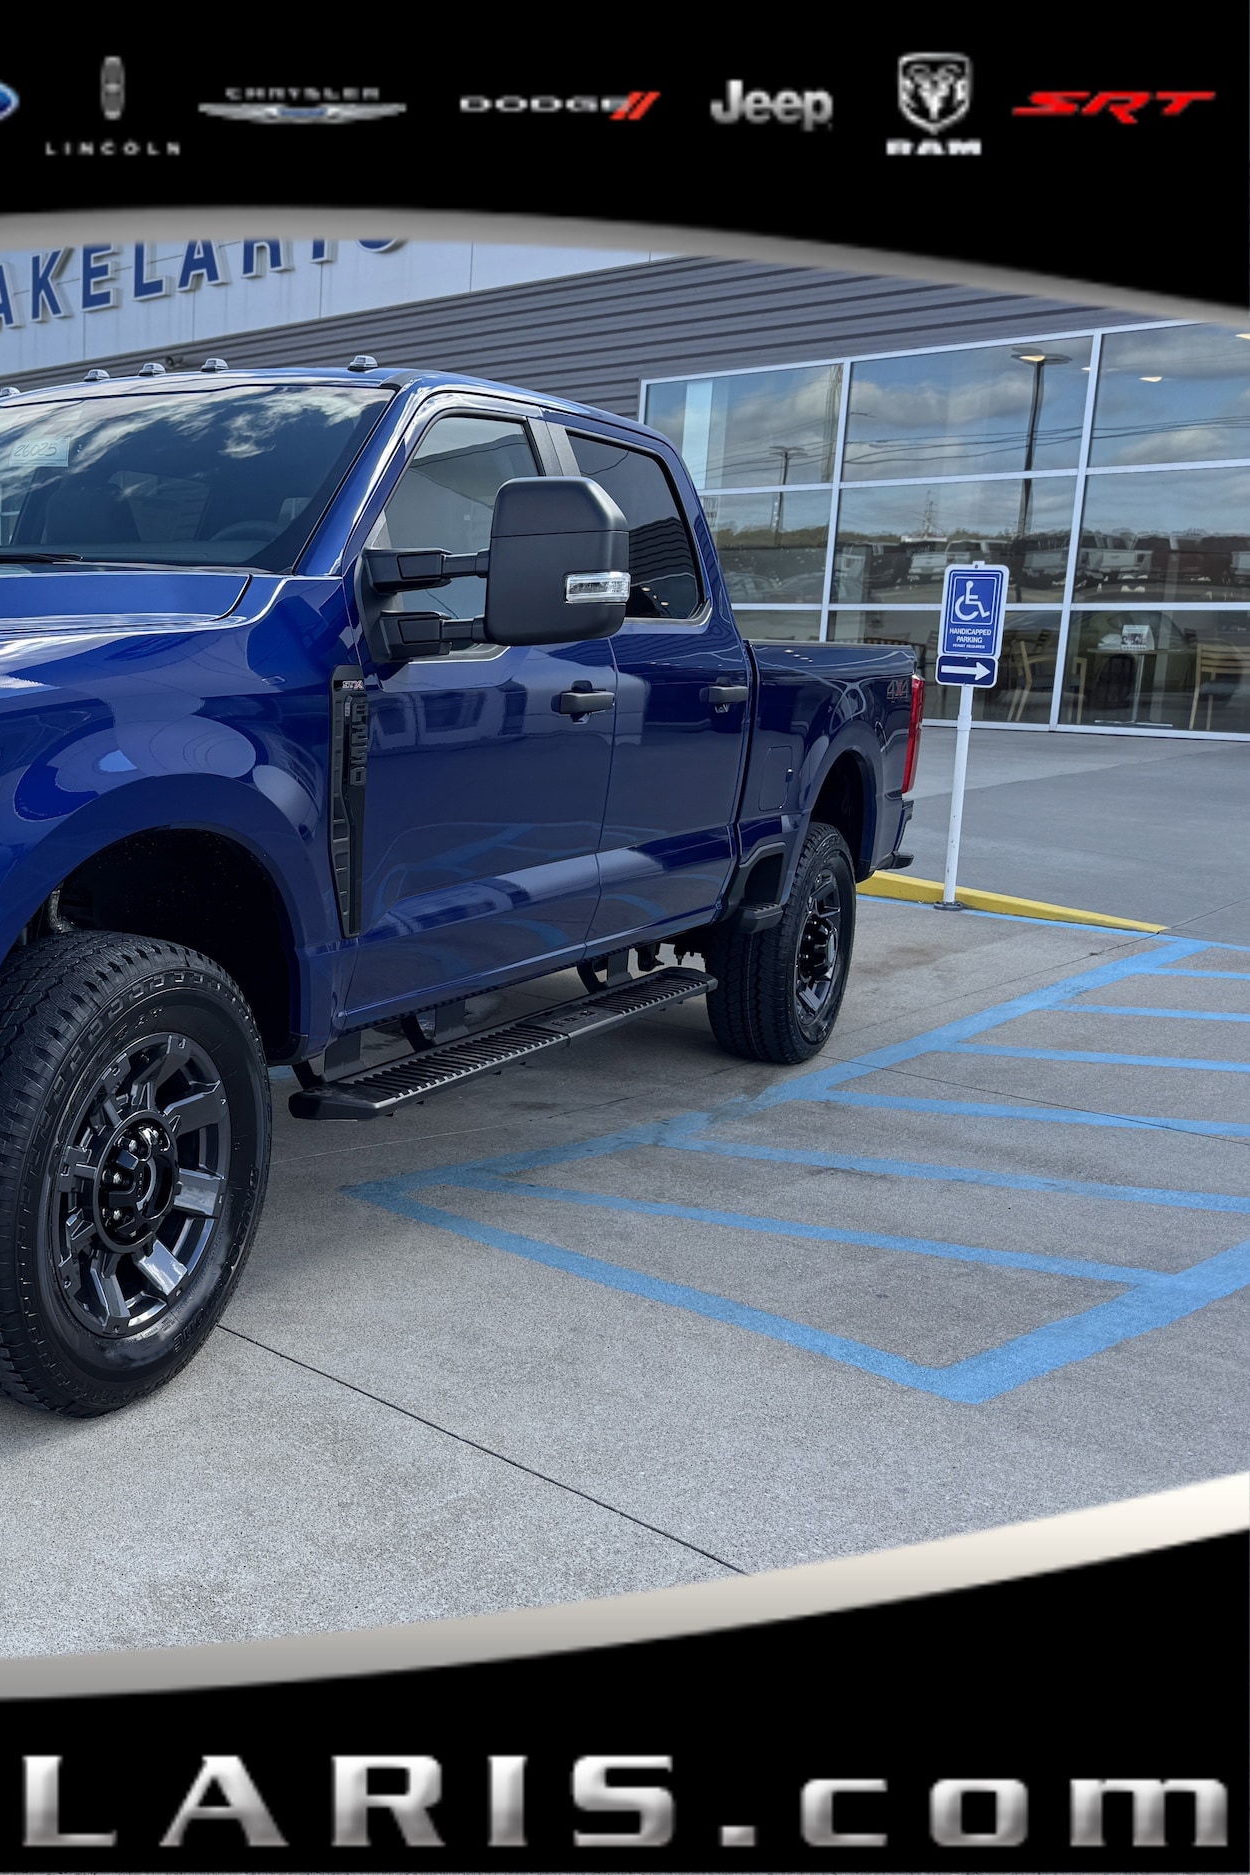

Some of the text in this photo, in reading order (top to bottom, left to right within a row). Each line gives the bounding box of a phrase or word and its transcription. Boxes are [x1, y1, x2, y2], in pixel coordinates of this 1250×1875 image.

[949, 627, 992, 636] HANDICAPPED
[956, 636, 983, 644] PARKING
[342, 680, 364, 690] STX
[172, 1164, 260, 1354] BRIDGONE
